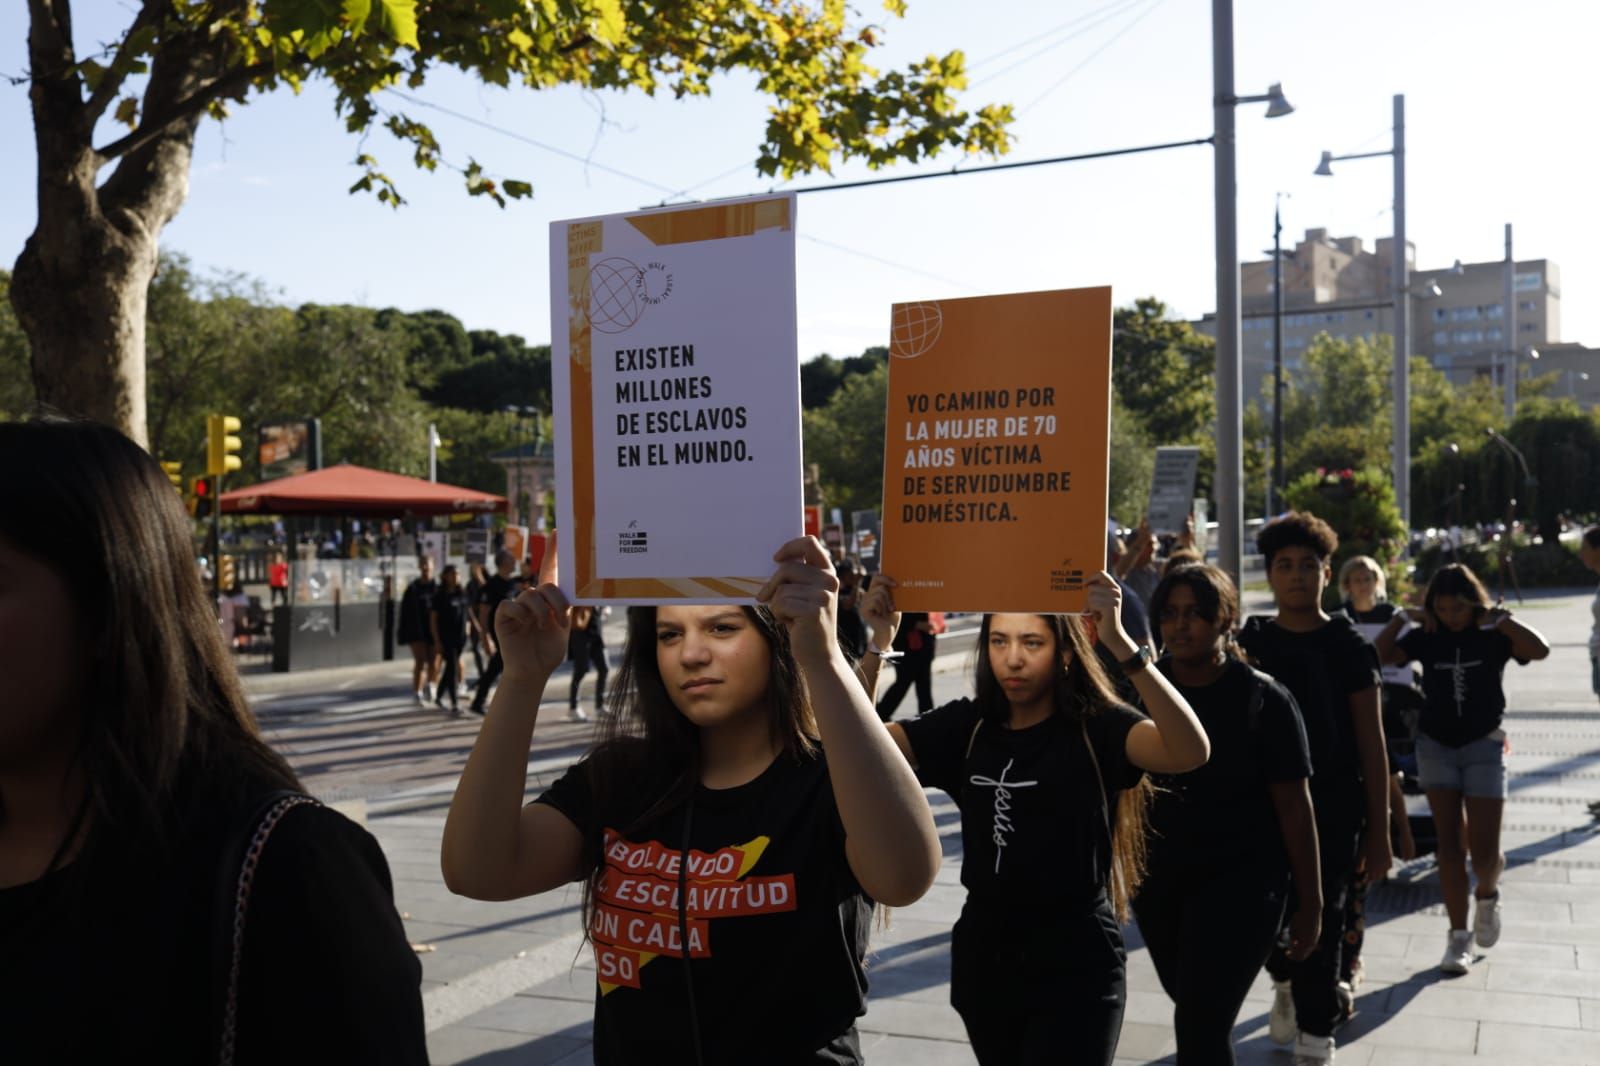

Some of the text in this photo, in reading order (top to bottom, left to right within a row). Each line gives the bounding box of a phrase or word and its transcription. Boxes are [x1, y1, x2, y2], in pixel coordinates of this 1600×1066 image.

[615, 344, 694, 371] EXISTEN
[616, 376, 712, 404] MILLONES
[907, 387, 1055, 413] YO CAMINO POR
[617, 406, 747, 435] DE ESCLAVOS
[906, 415, 1056, 441] LA MUJER DE 70
[618, 439, 753, 467] EN EL MUNDO.
[904, 442, 1042, 469] AÑOS VÍCTIMA
[903, 472, 1071, 495] DE SERVIDUMBRE
[902, 500, 1017, 524] DOMÉSTICA.
[605, 834, 734, 877] BOLIENDO
[615, 879, 788, 911] ESCLAVITUD
[593, 911, 703, 952] ON CADA
